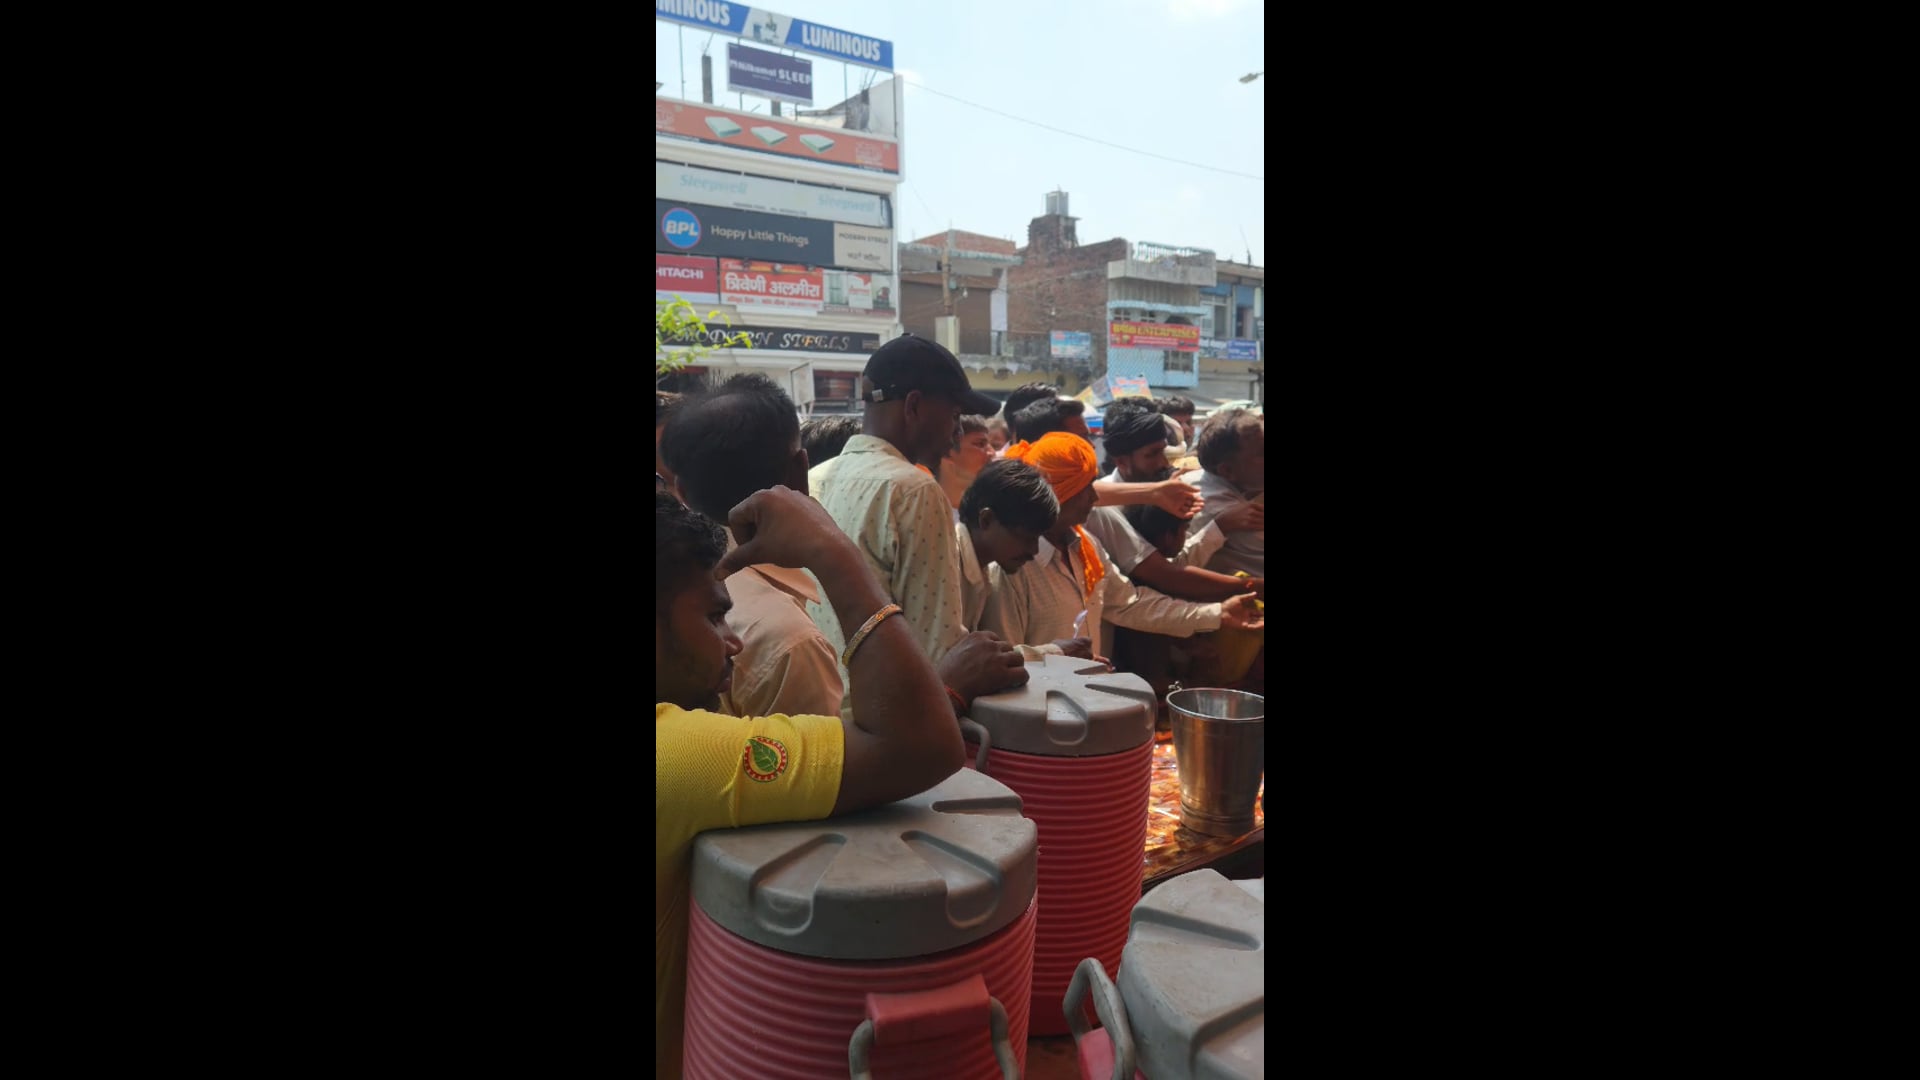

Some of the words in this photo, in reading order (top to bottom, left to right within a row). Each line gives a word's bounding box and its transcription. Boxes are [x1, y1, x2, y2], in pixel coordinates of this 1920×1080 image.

[656, 0, 730, 26] MINOUS
[802, 23, 880, 62] LUMINOUS
[680, 174, 747, 194] Sleepwell
[665, 220, 698, 236] BPL
[711, 225, 746, 240] Happy
[748, 229, 775, 241] Little
[776, 232, 809, 247] Things
[656, 266, 704, 280] HITACHI
[725, 272, 766, 293] त्रिवेणी
